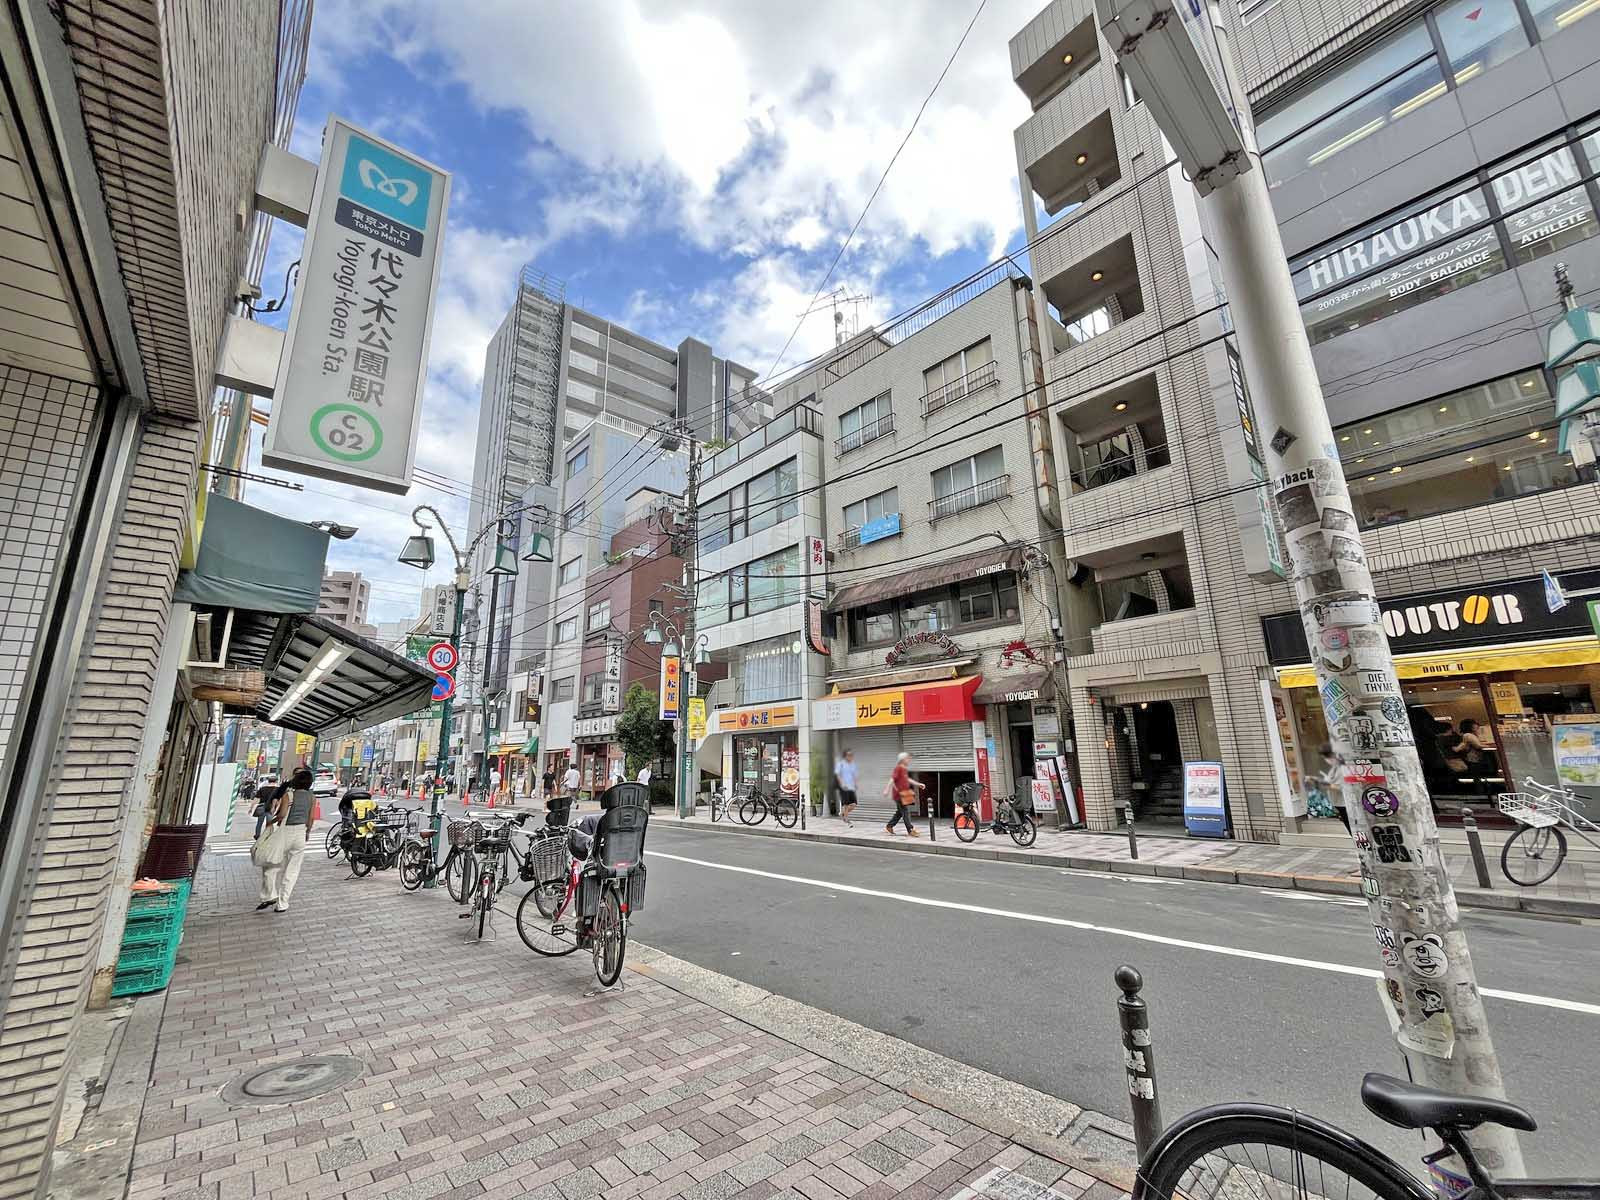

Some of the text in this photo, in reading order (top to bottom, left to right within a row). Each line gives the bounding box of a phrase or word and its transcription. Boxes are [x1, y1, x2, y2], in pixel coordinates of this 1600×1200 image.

[351, 208, 411, 241] 東京メトロ
[353, 218, 406, 247] Tokyo Metro
[1306, 193, 1482, 290] HIRAOKA
[1389, 211, 1587, 298] BODY BALANCE ATHLETE
[321, 239, 366, 377] Yoyogi-koen Sta.
[347, 247, 405, 407] 代々木公園駅
[342, 414, 358, 430] C
[328, 428, 363, 451] 02
[975, 561, 1007, 577] YOYOGIEN
[1382, 594, 1524, 638] OUTOR
[435, 650, 451, 664] 30
[667, 679, 676, 702] 松屋
[1005, 689, 1039, 702] YOYOGIEN
[750, 710, 770, 726] 松屋
[858, 700, 902, 720] カレー屋
